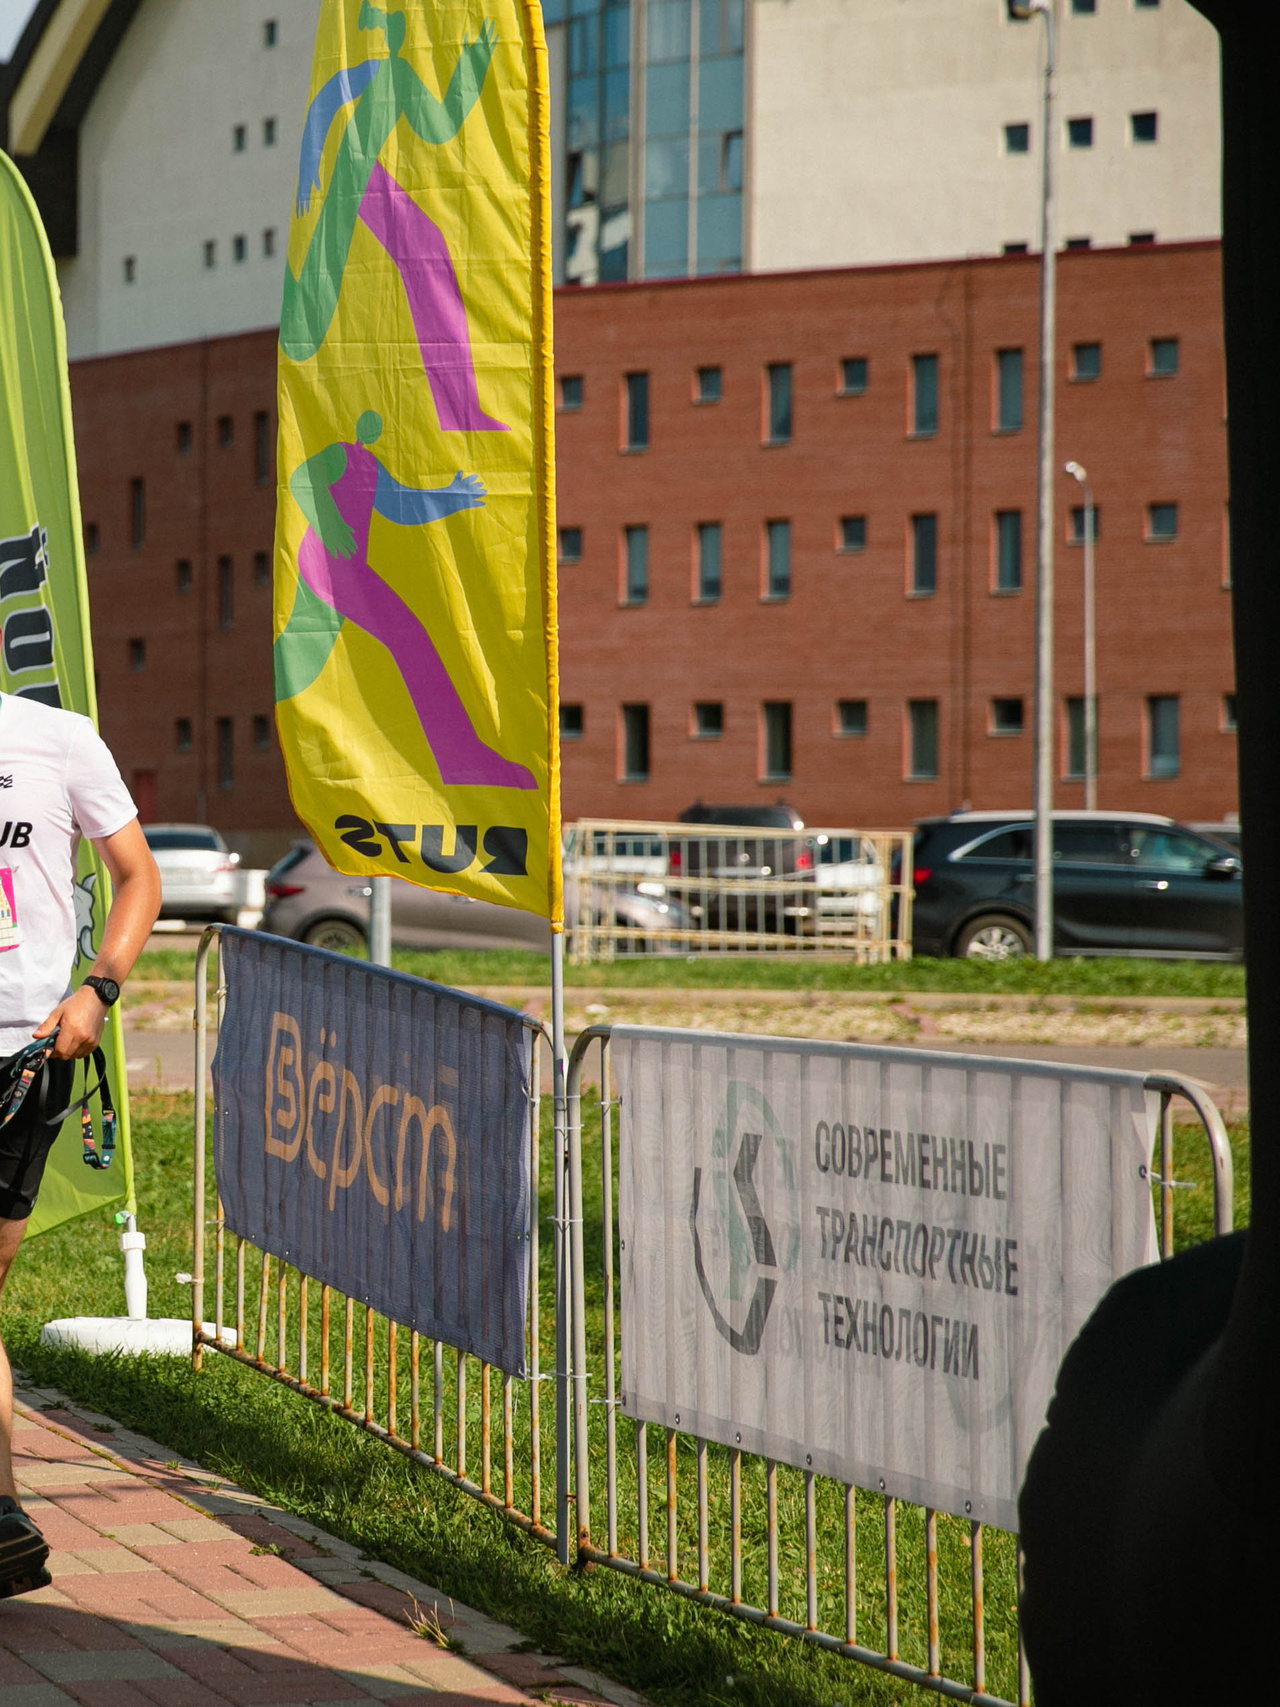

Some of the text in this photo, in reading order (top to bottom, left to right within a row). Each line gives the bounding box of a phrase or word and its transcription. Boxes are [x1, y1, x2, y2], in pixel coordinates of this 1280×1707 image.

[815, 1120, 1006, 1200] СОВРЕМЕННЫЕ
[816, 1205, 1018, 1296] ТРАНСПОРТНЫЕ
[817, 1291, 979, 1380] ТЕХНОЛОГИИ
